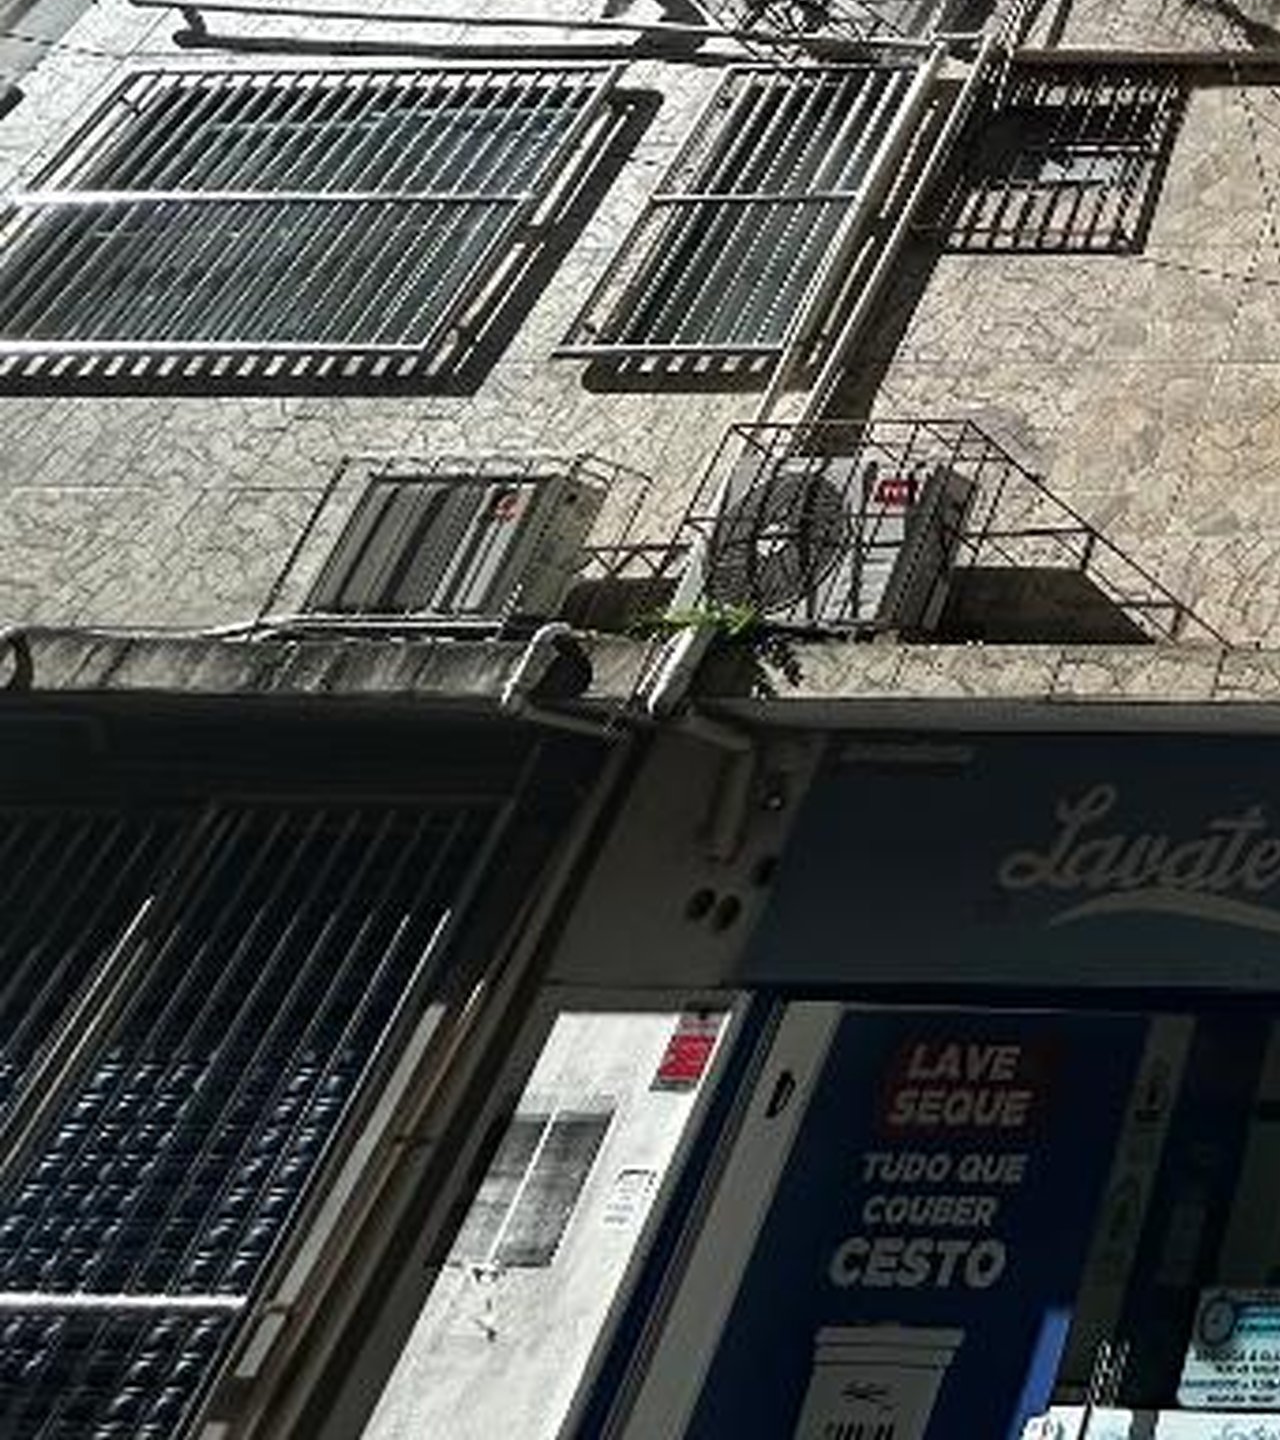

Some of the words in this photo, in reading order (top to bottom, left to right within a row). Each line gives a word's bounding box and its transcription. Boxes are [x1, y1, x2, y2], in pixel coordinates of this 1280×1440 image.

[907, 1042, 1022, 1082] LAVE
[886, 1089, 1034, 1127] SEQUE
[860, 1152, 952, 1184] TUDO
[959, 1153, 1029, 1185] QUE
[862, 1194, 999, 1228] COUBER
[829, 1235, 1008, 1289] CESTO
